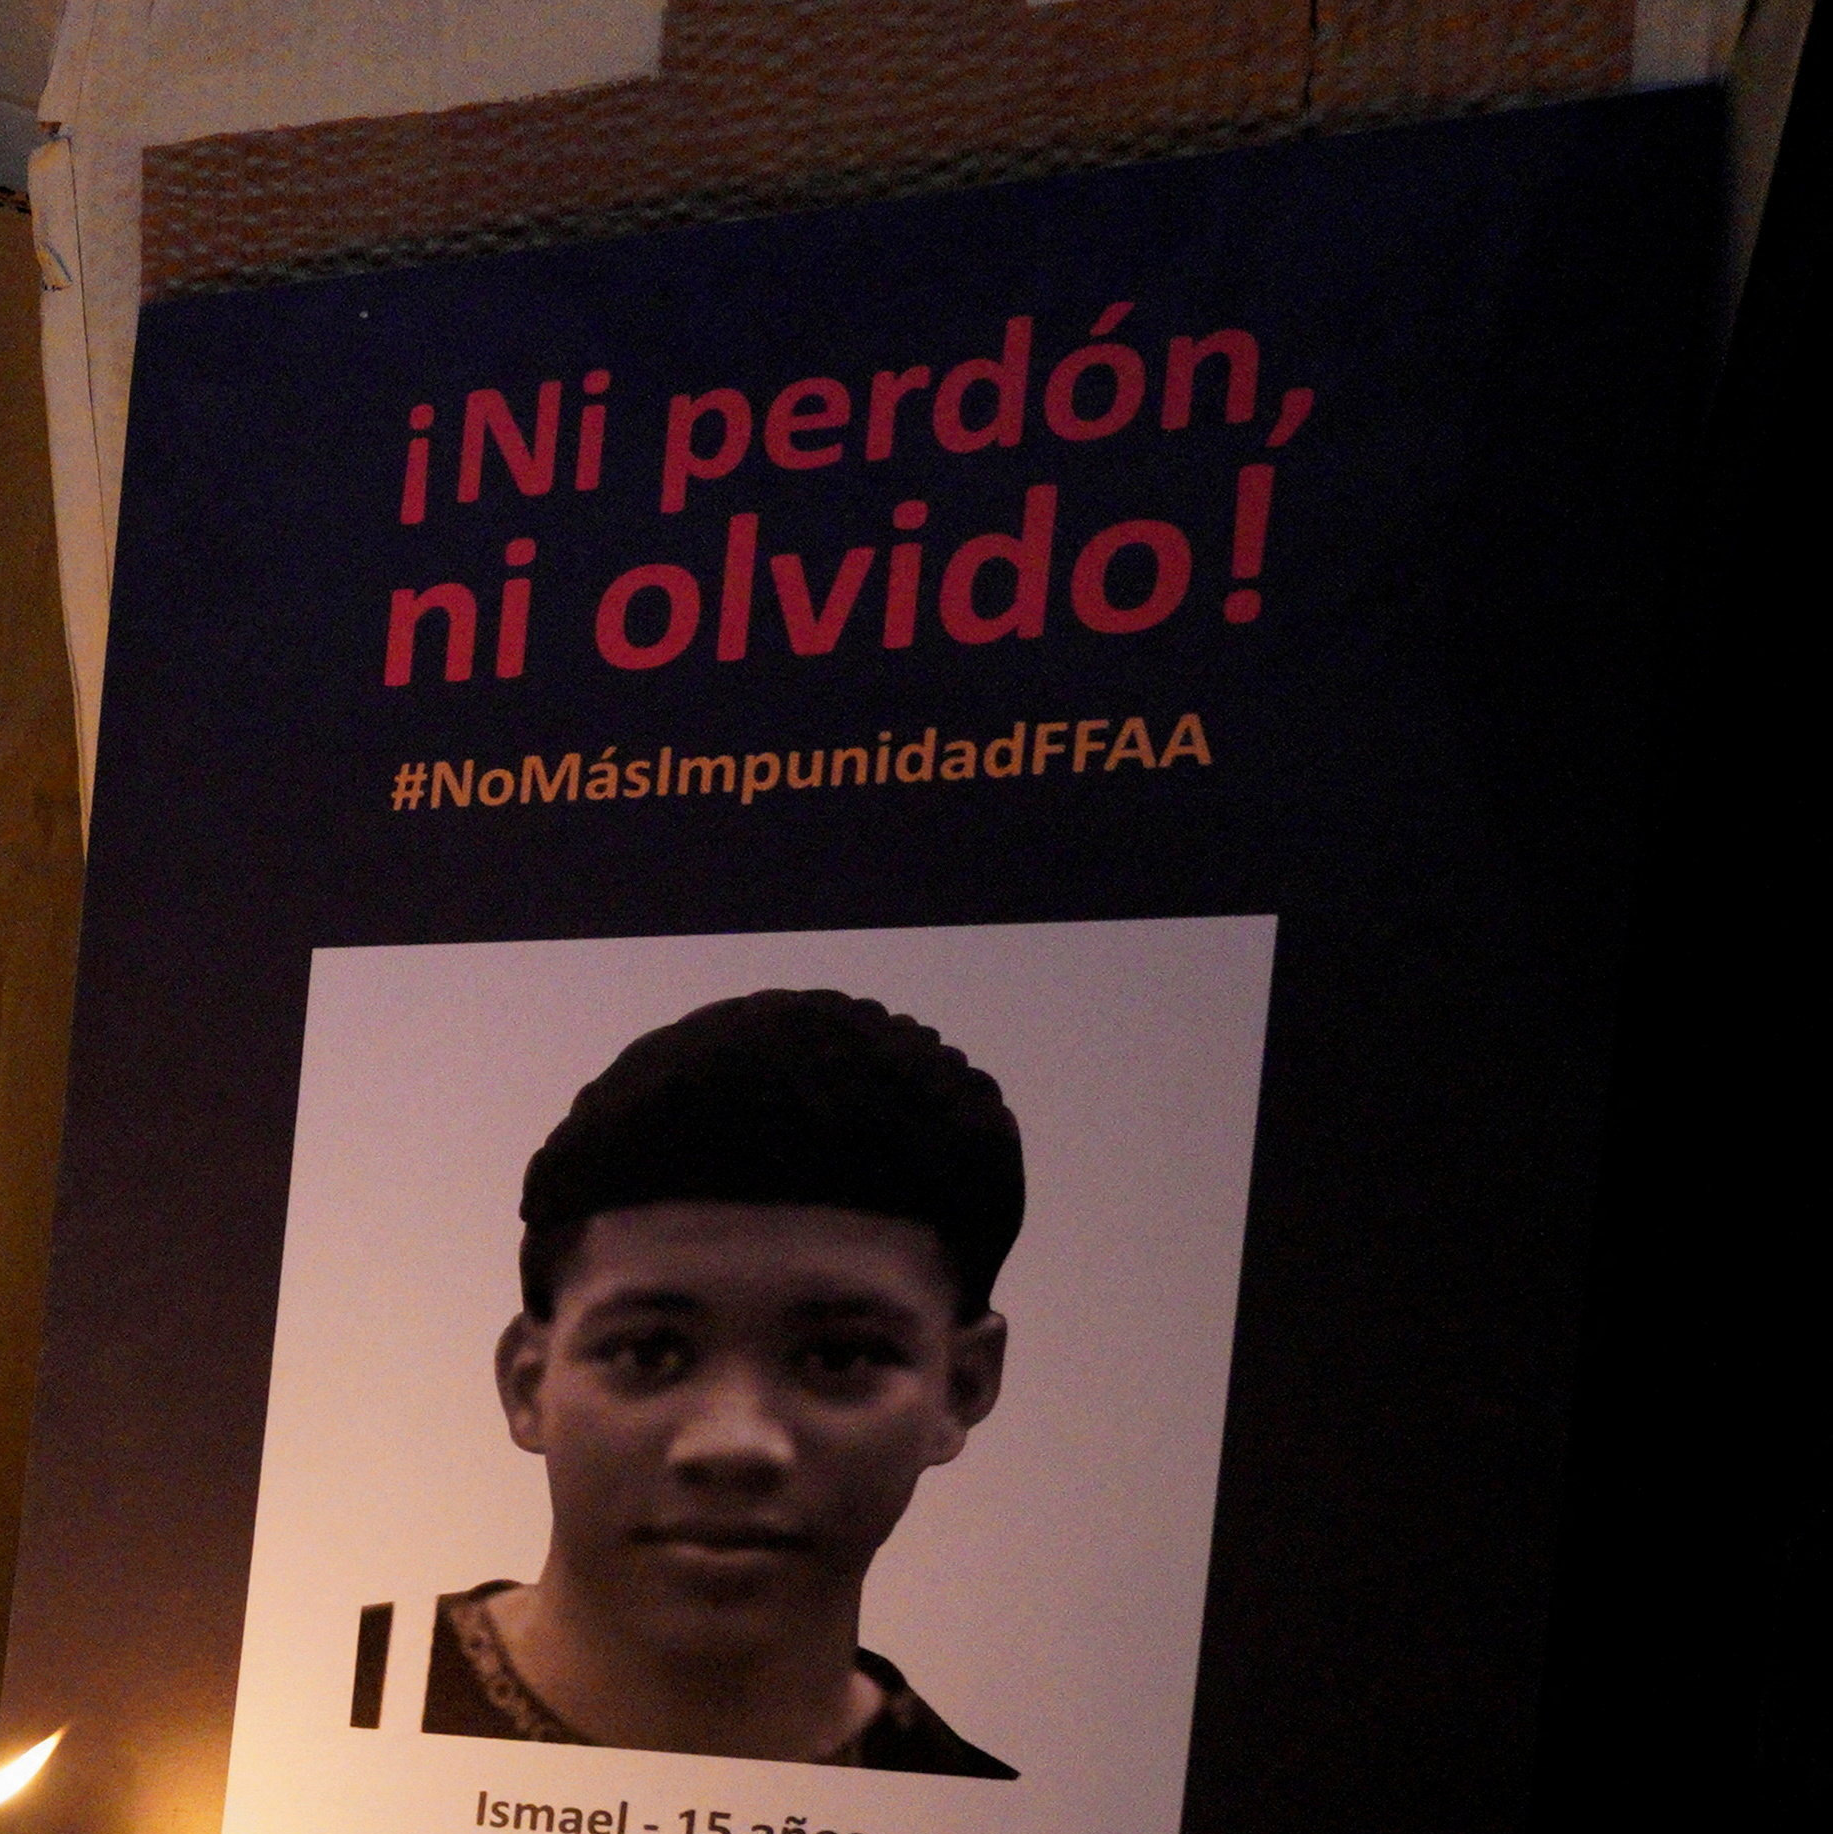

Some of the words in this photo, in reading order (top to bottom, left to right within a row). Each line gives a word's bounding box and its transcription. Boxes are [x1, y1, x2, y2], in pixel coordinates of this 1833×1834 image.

[399, 368, 612, 526] ¡Ni
[659, 301, 1314, 514] perdón,
[383, 538, 536, 687] ni
[594, 462, 1275, 671] olvido!
[390, 713, 1212, 811] #NoMásImpunidadFFAA
